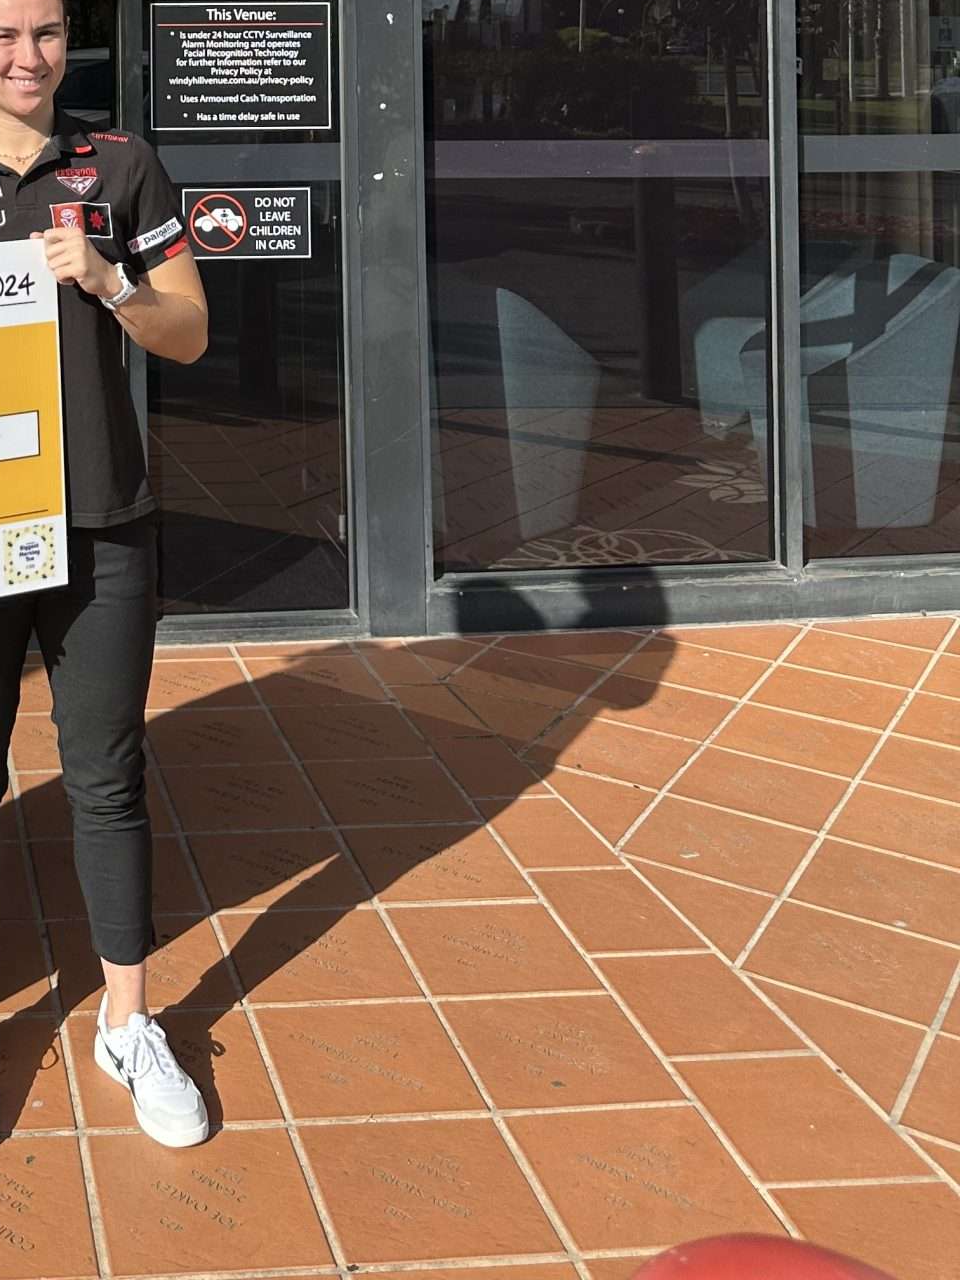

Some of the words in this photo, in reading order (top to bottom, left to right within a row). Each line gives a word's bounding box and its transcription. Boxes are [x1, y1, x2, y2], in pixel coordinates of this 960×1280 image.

[207, 9, 232, 20] This
[234, 9, 276, 20] Venue:
[180, 31, 188, 39] Is
[189, 31, 210, 39] under
[212, 31, 222, 39] 24
[180, 95, 198, 103] Uses
[200, 95, 239, 103] Armoured
[261, 94, 316, 104] Transportation
[255, 198, 272, 207] DO
[274, 197, 295, 207] NOT
[260, 212, 290, 221] LEAVE
[250, 226, 301, 236] CHILDREN
[256, 240, 268, 250] IN
[270, 240, 295, 250] CARS
